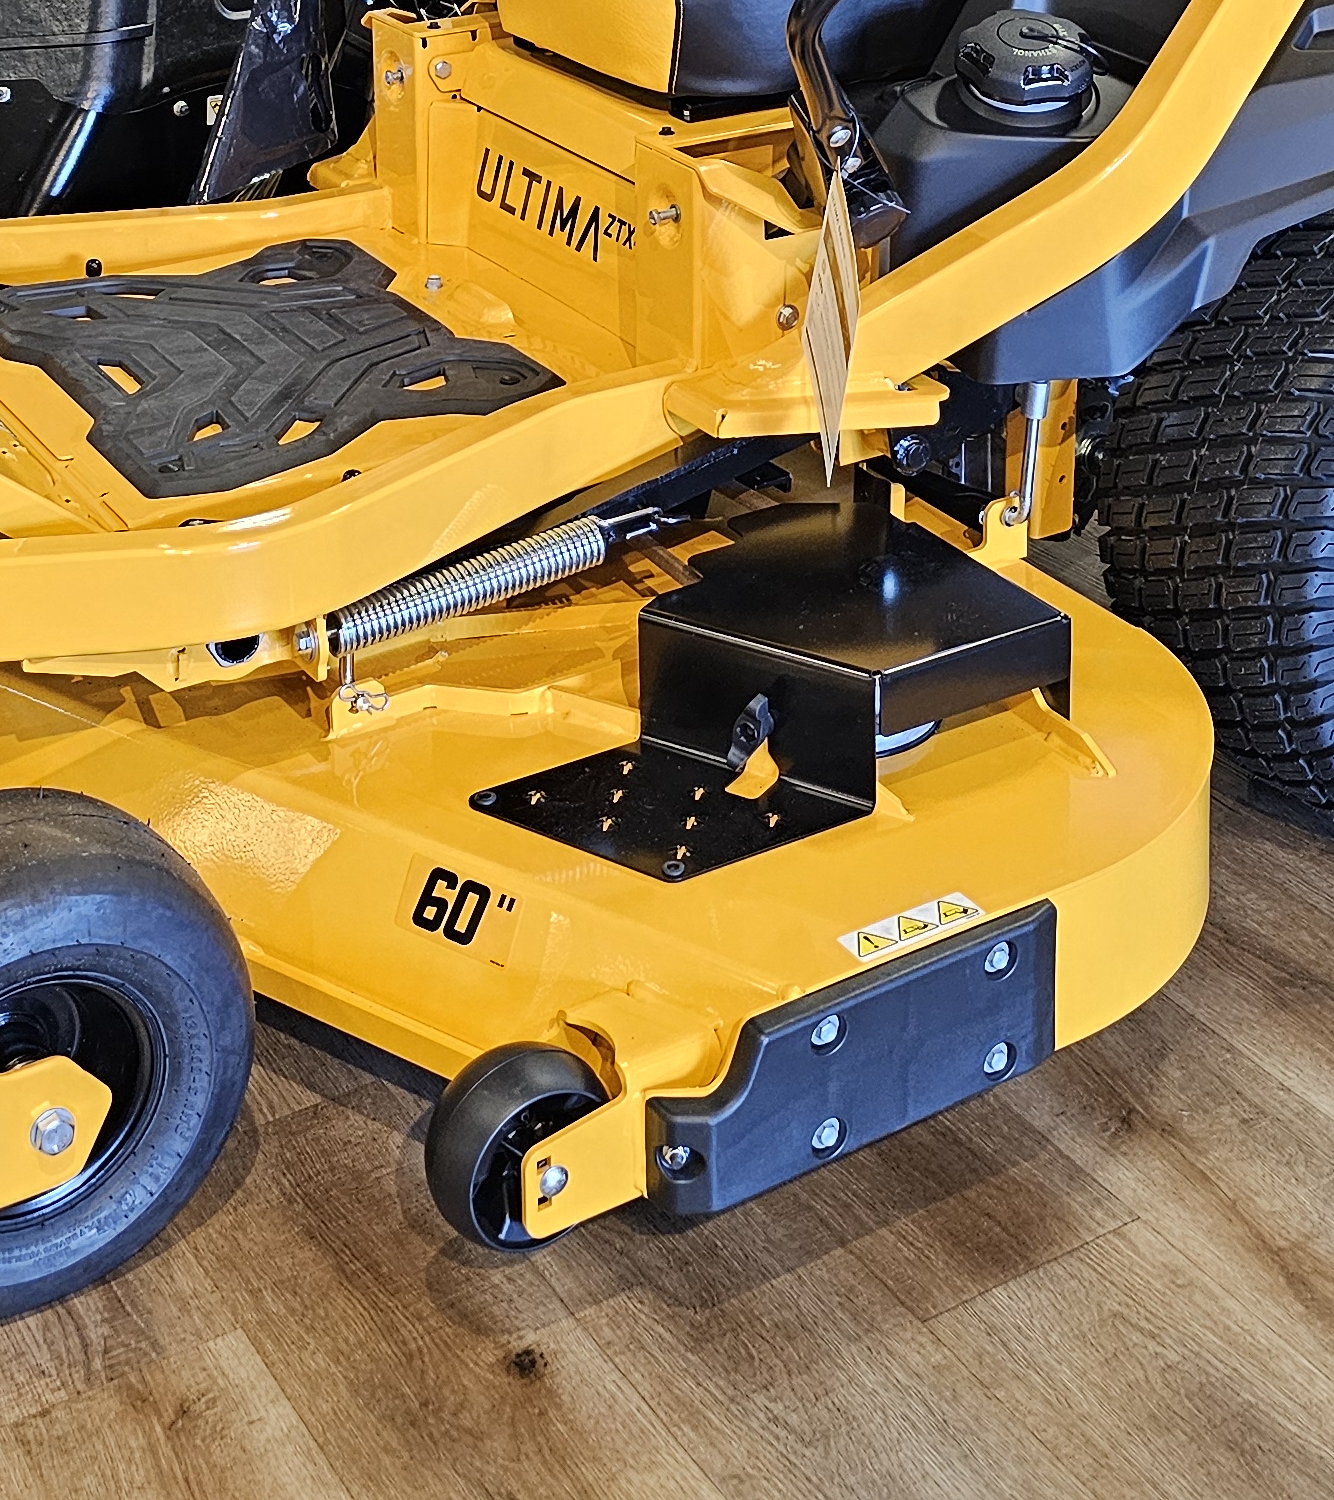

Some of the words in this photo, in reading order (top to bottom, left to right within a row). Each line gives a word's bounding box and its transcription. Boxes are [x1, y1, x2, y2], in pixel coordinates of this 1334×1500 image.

[476, 147, 601, 262] ULTIMA
[602, 212, 636, 250] ZTX
[411, 866, 516, 946] 60"
